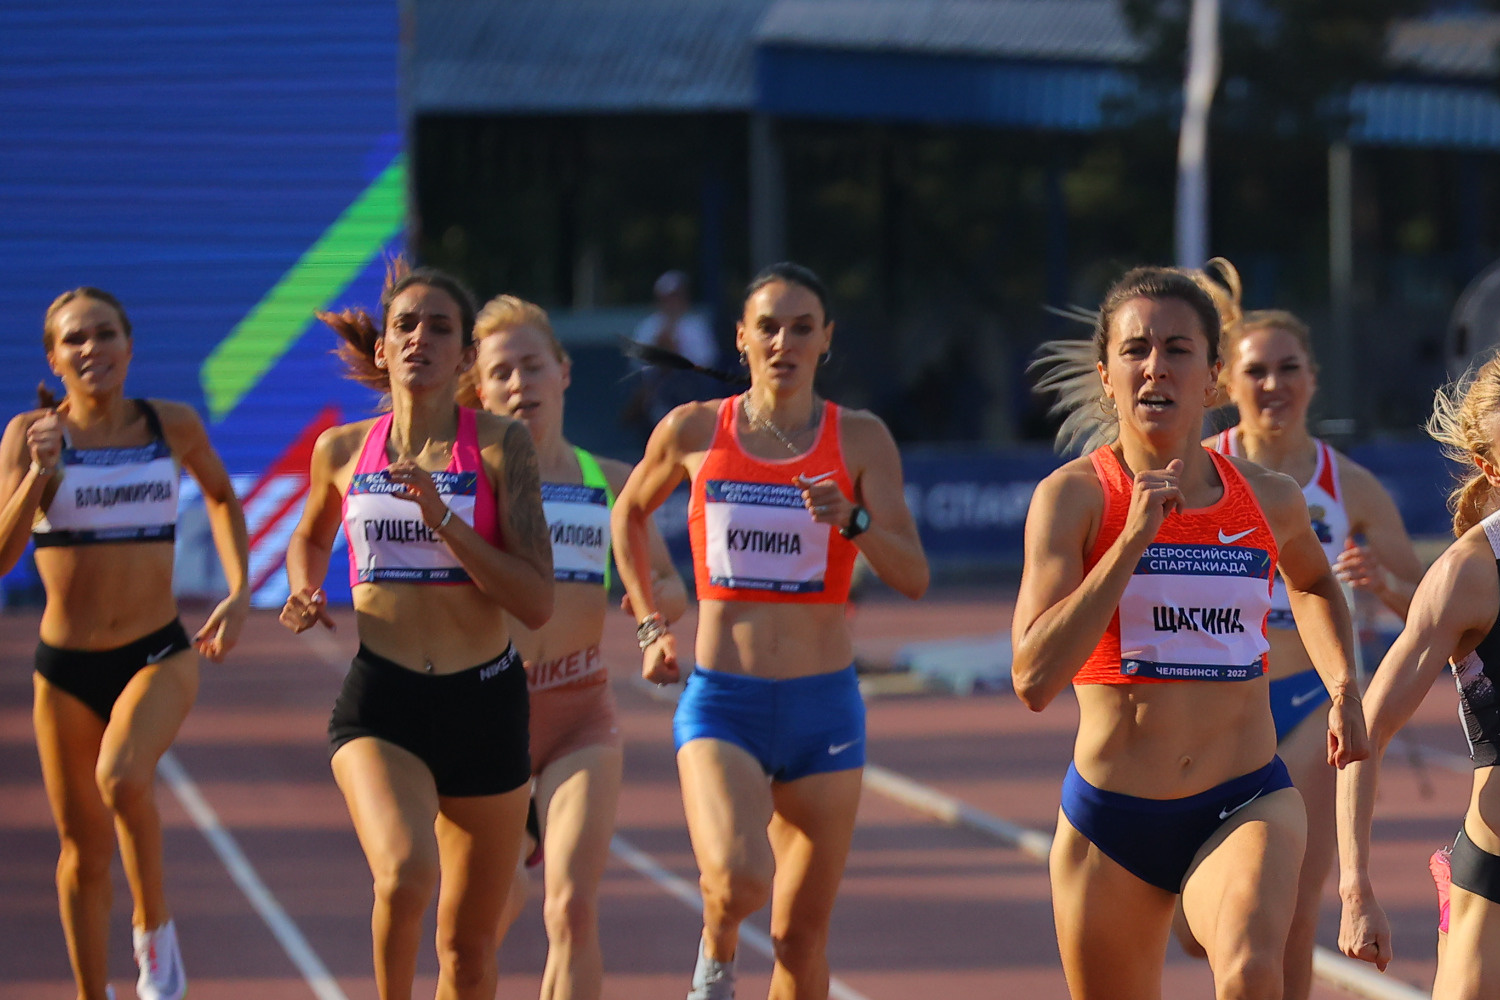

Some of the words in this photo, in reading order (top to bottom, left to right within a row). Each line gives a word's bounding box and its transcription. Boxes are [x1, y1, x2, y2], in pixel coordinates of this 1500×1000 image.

[75, 480, 172, 509] ВЛАДИМИРОВА
[550, 520, 603, 547] ЙЛОВА
[727, 529, 801, 554] КУПИНА
[1141, 547, 1253, 561] ВСЕРОССИЙСКАЯ
[1150, 559, 1248, 574] СПАРТАКИАДА
[1153, 606, 1245, 635] ЩАГИНА
[480, 658, 509, 681] NIKE
[1156, 666, 1219, 677] ЧЕЛЯБИНСК
[1226, 669, 1248, 678] 2022
